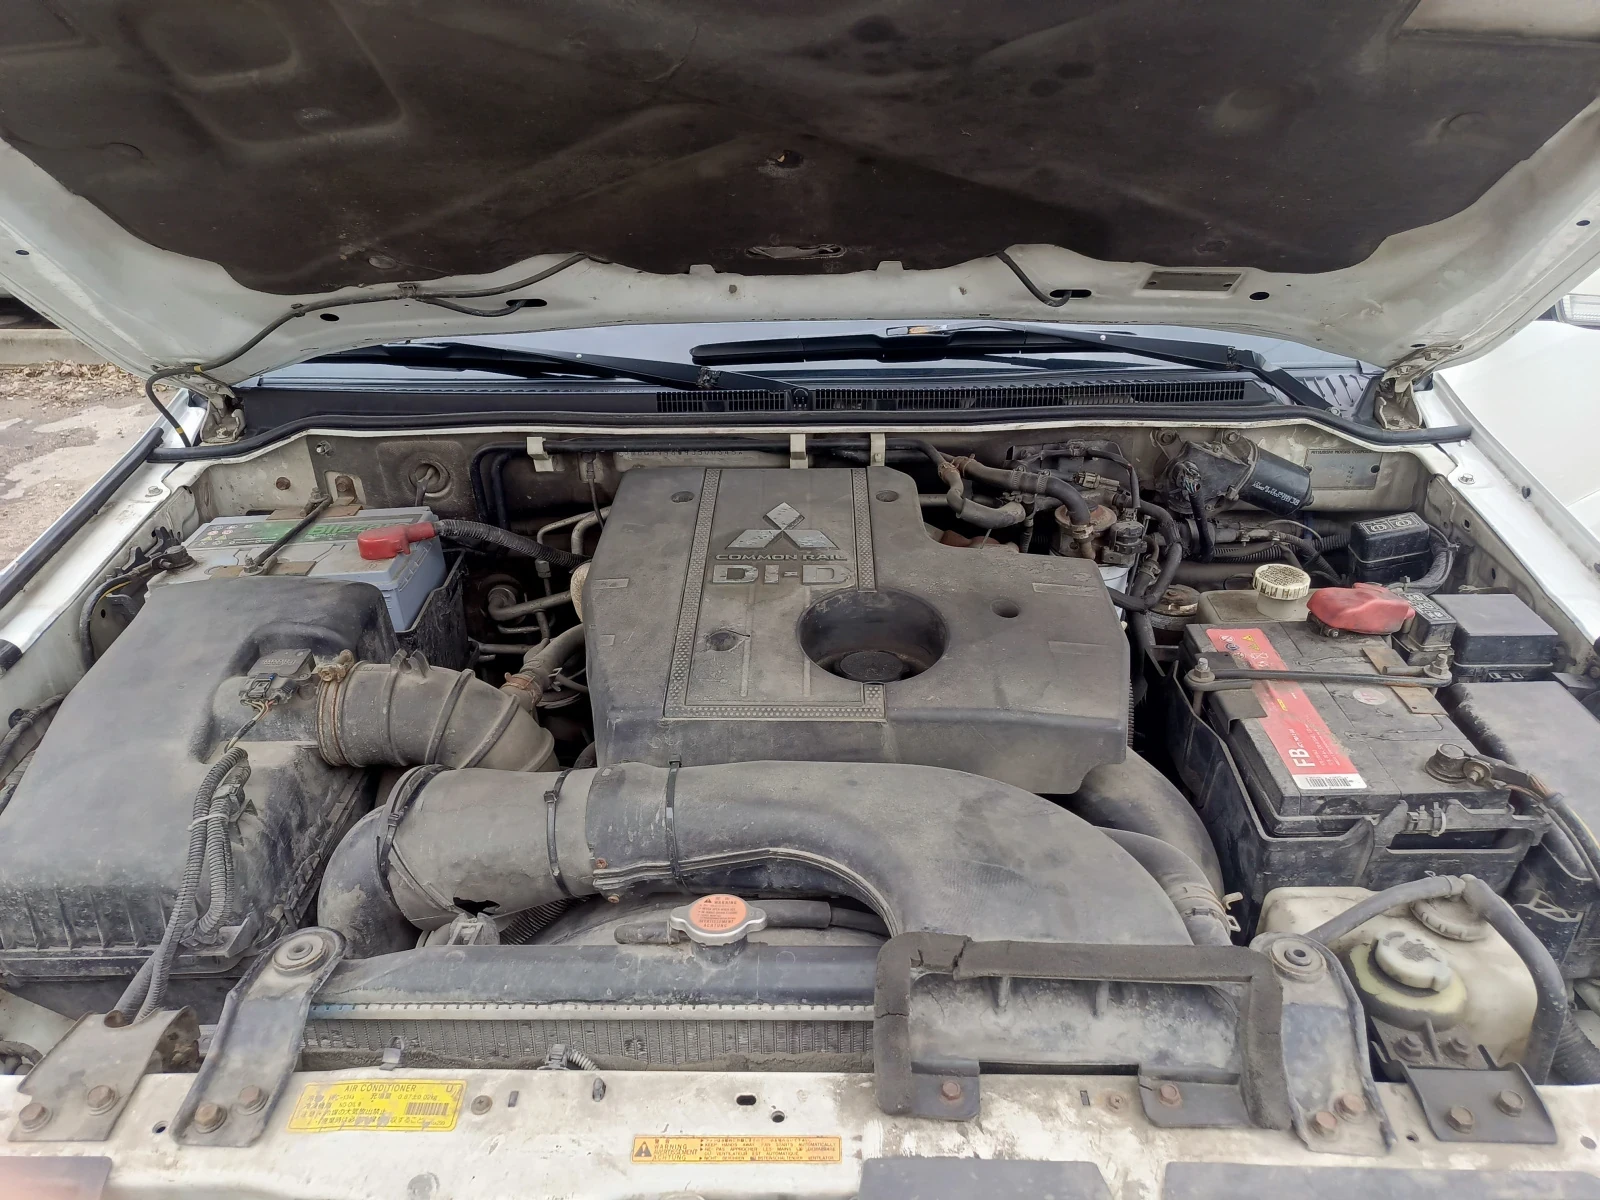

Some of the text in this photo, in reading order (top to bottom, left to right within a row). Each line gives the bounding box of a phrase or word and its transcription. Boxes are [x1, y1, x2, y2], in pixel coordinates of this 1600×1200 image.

[715, 553, 848, 561] COMMON RAIL
[712, 564, 855, 585] DI-D
[1288, 748, 1315, 767] FB
[344, 1084, 417, 1092] AIR CONDITIONER
